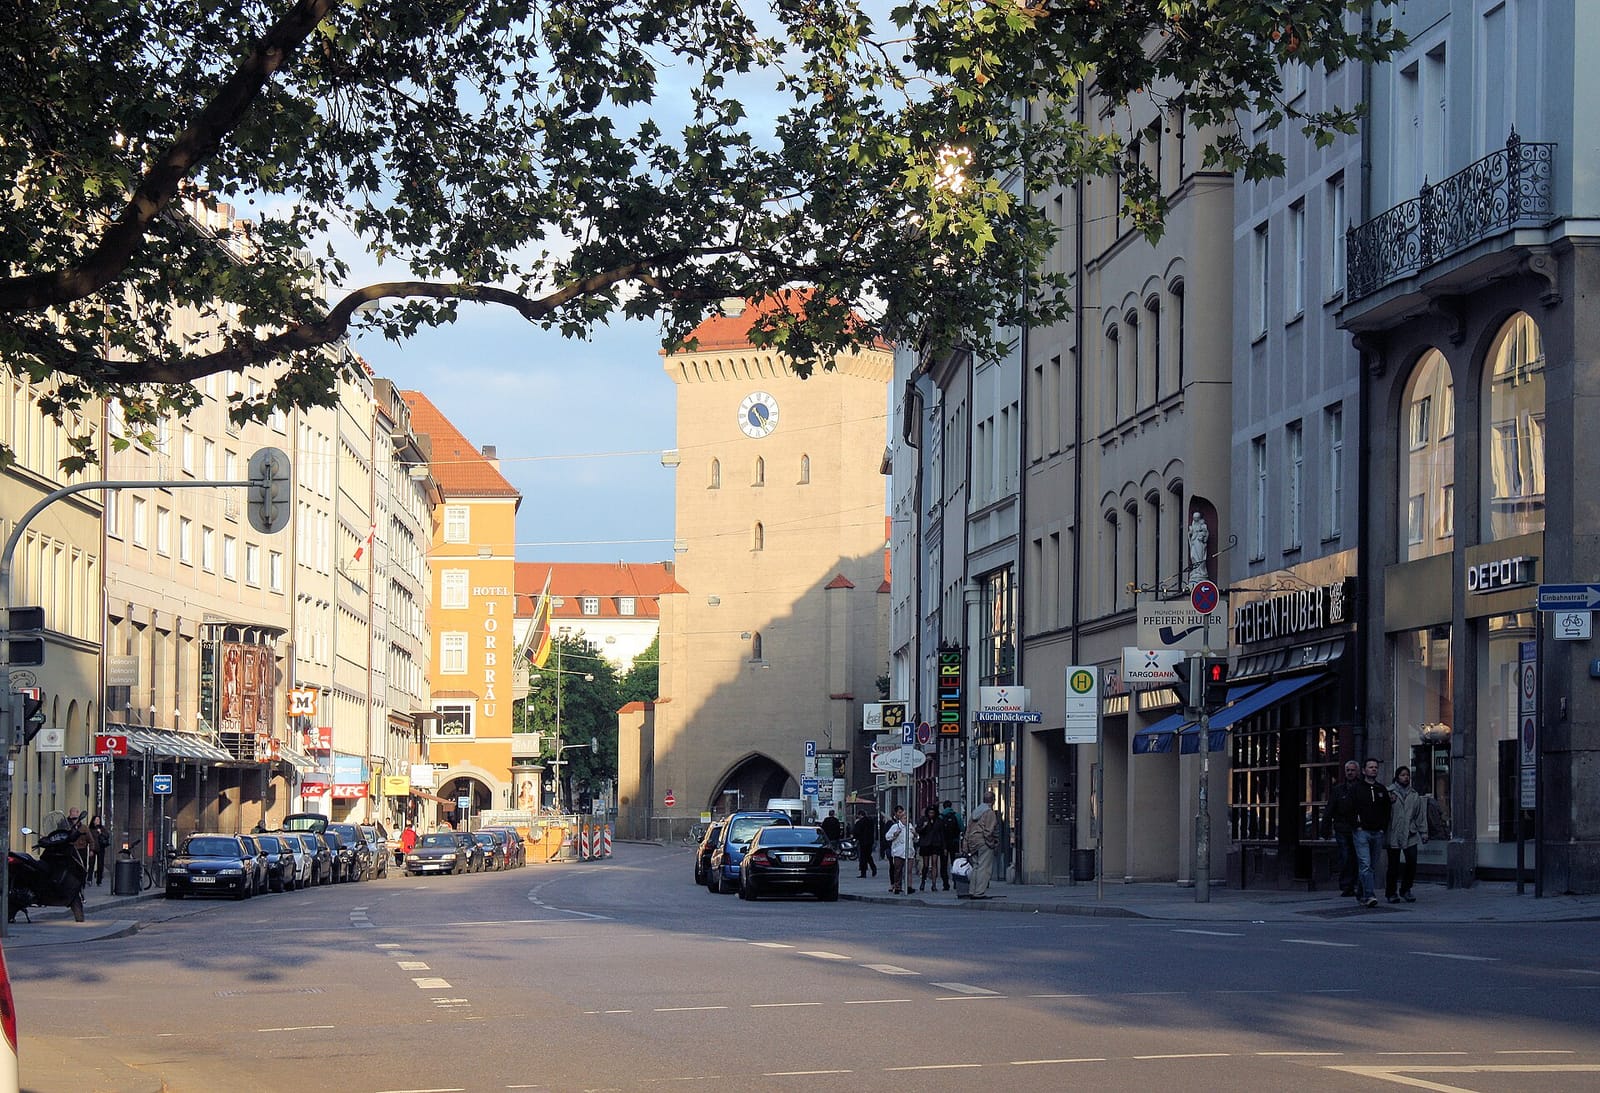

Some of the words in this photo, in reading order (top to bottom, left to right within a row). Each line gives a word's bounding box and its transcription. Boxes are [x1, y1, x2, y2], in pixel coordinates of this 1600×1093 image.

[1468, 557, 1522, 591] DEPOT
[473, 587, 510, 596] HOTEL
[1144, 616, 1184, 625] PFEIFEN
[1188, 616, 1222, 625] HUER
[1233, 598, 1279, 644] PFEIFEN
[1281, 586, 1324, 637] HUBER
[484, 602, 498, 717] TORBRÄU
[1077, 675, 1087, 689] H
[941, 653, 960, 733] BUTLERS
[296, 697, 310, 709] M
[979, 713, 1039, 722] Küchelbäckerstr.
[903, 726, 911, 743] P
[806, 743, 813, 756] P
[302, 786, 322, 794] KFC
[333, 785, 365, 797] KFC
